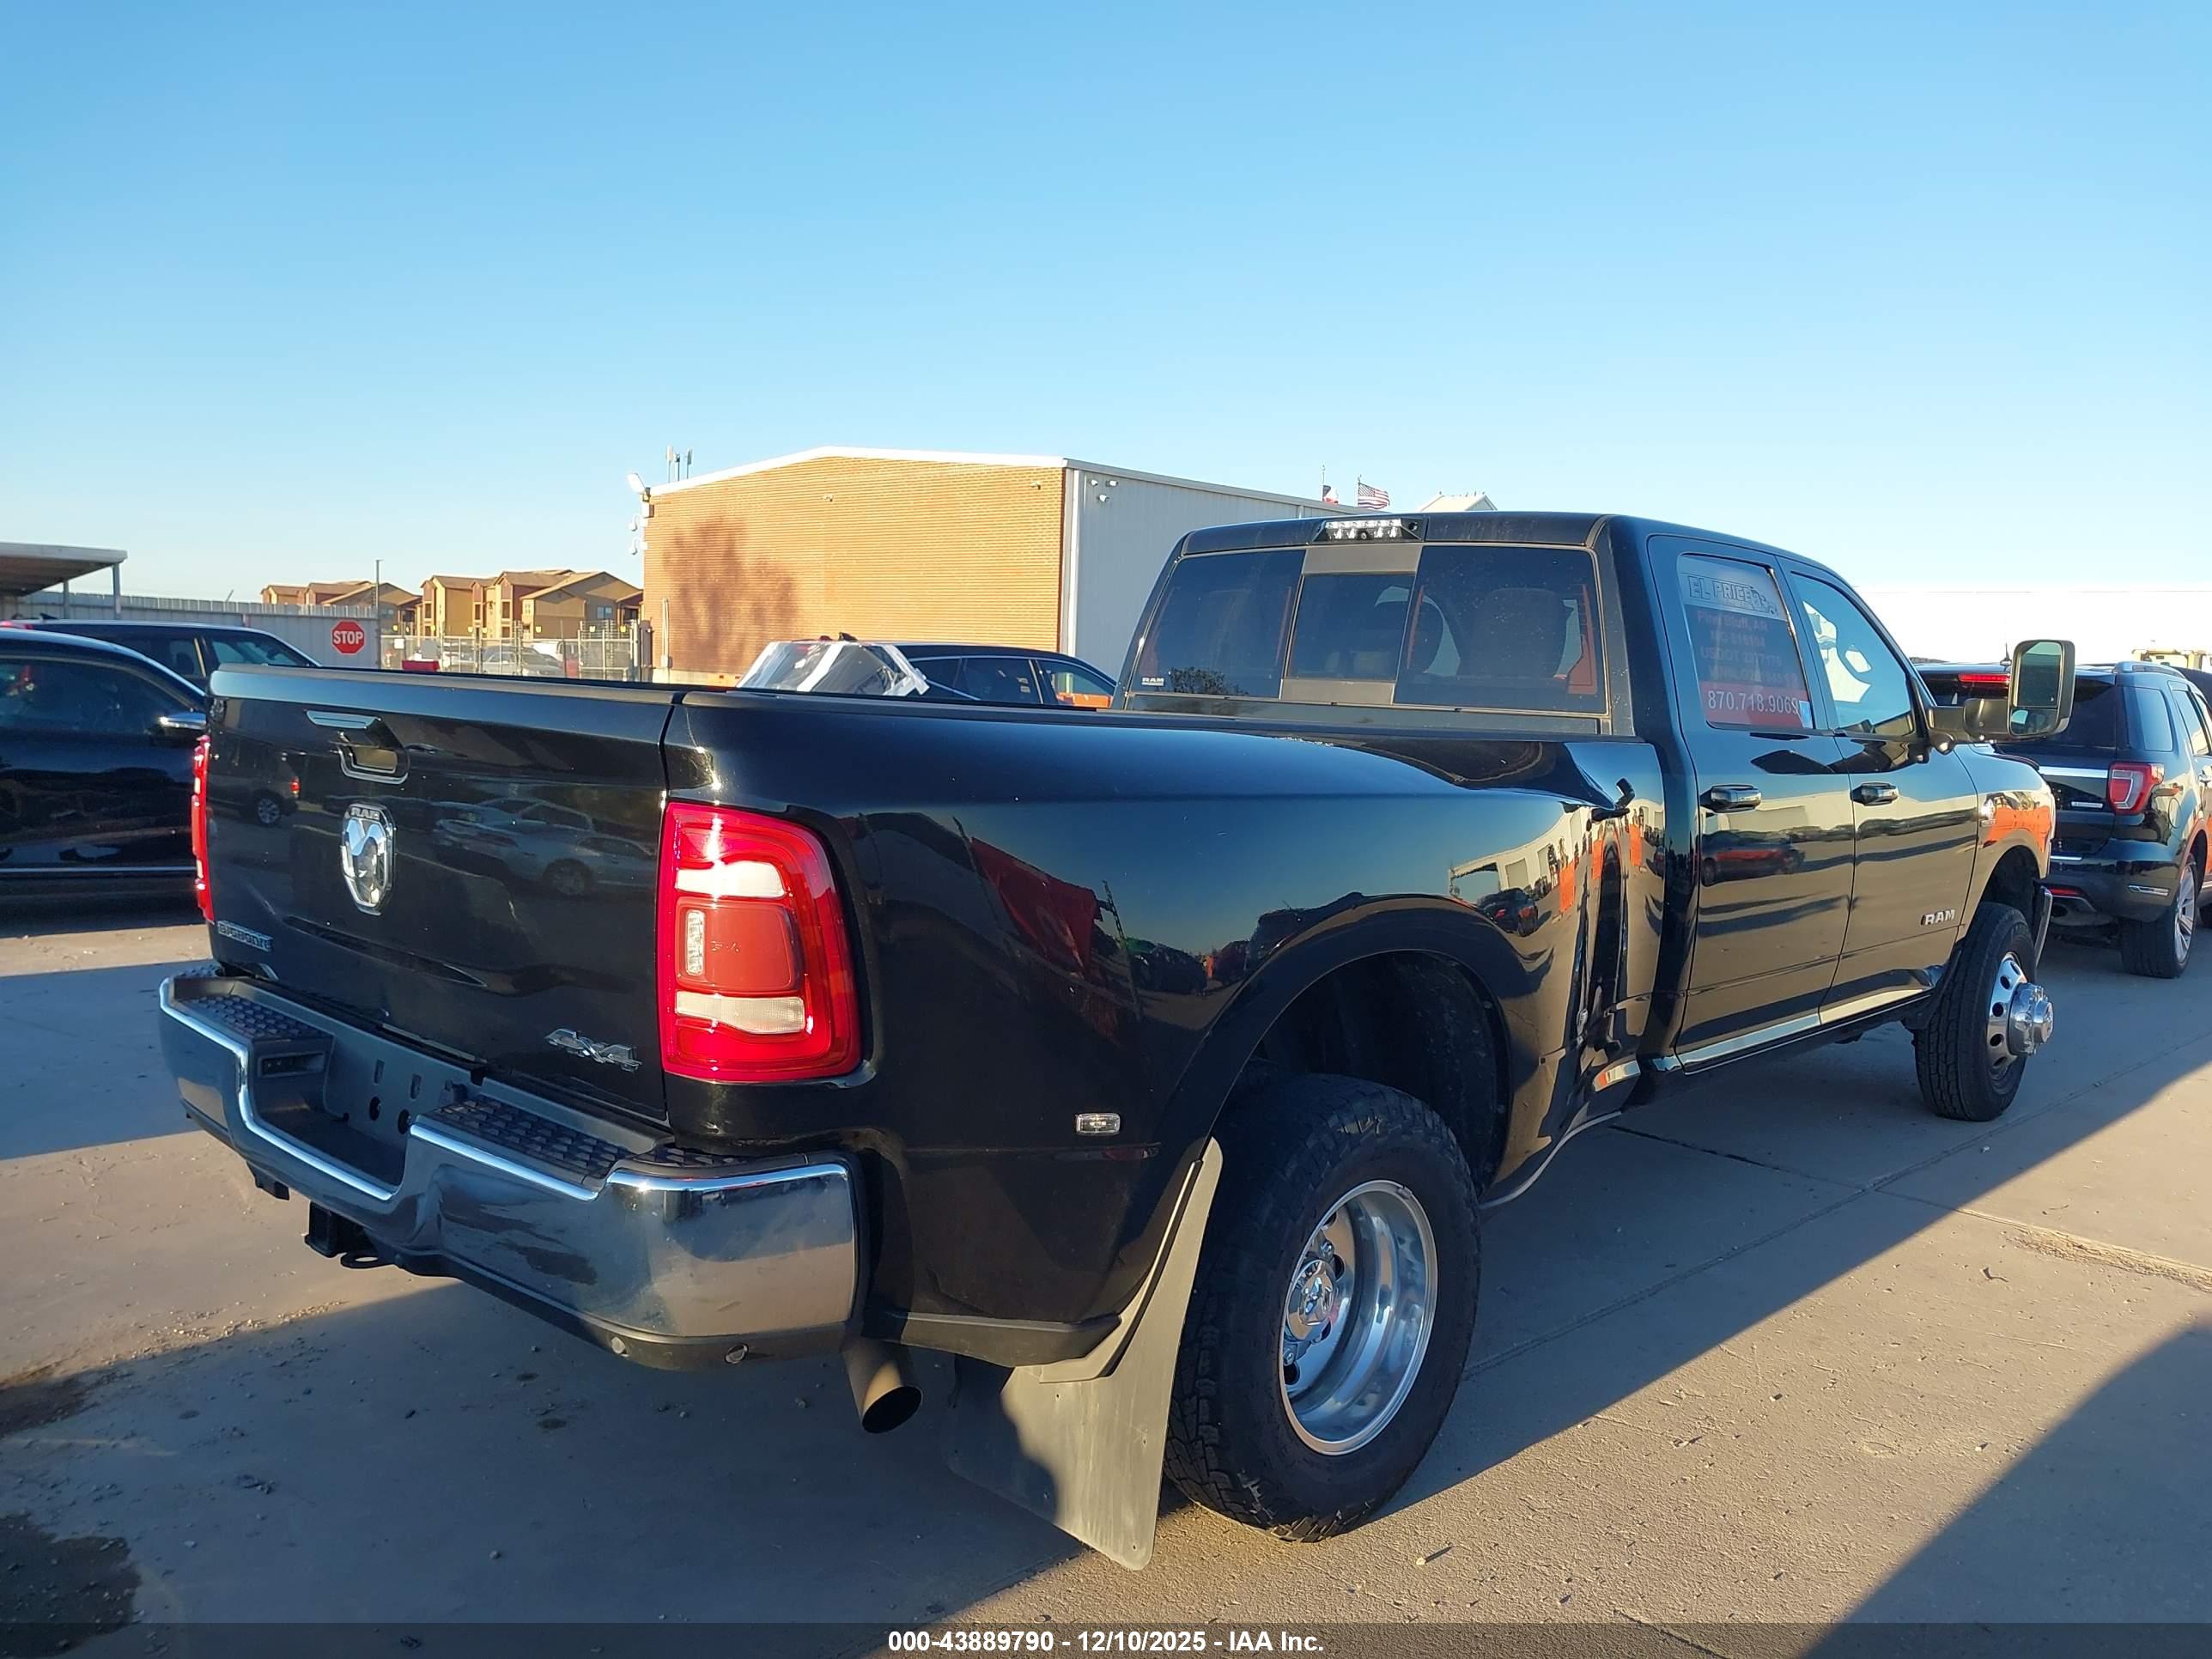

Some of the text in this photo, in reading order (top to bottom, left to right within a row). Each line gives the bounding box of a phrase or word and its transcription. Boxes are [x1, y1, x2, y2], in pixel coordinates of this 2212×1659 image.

[333, 630, 364, 645] STOP
[1708, 690, 1799, 714] 870.718.9069
[350, 807, 380, 821] RAM
[1921, 909, 1955, 926] RAM
